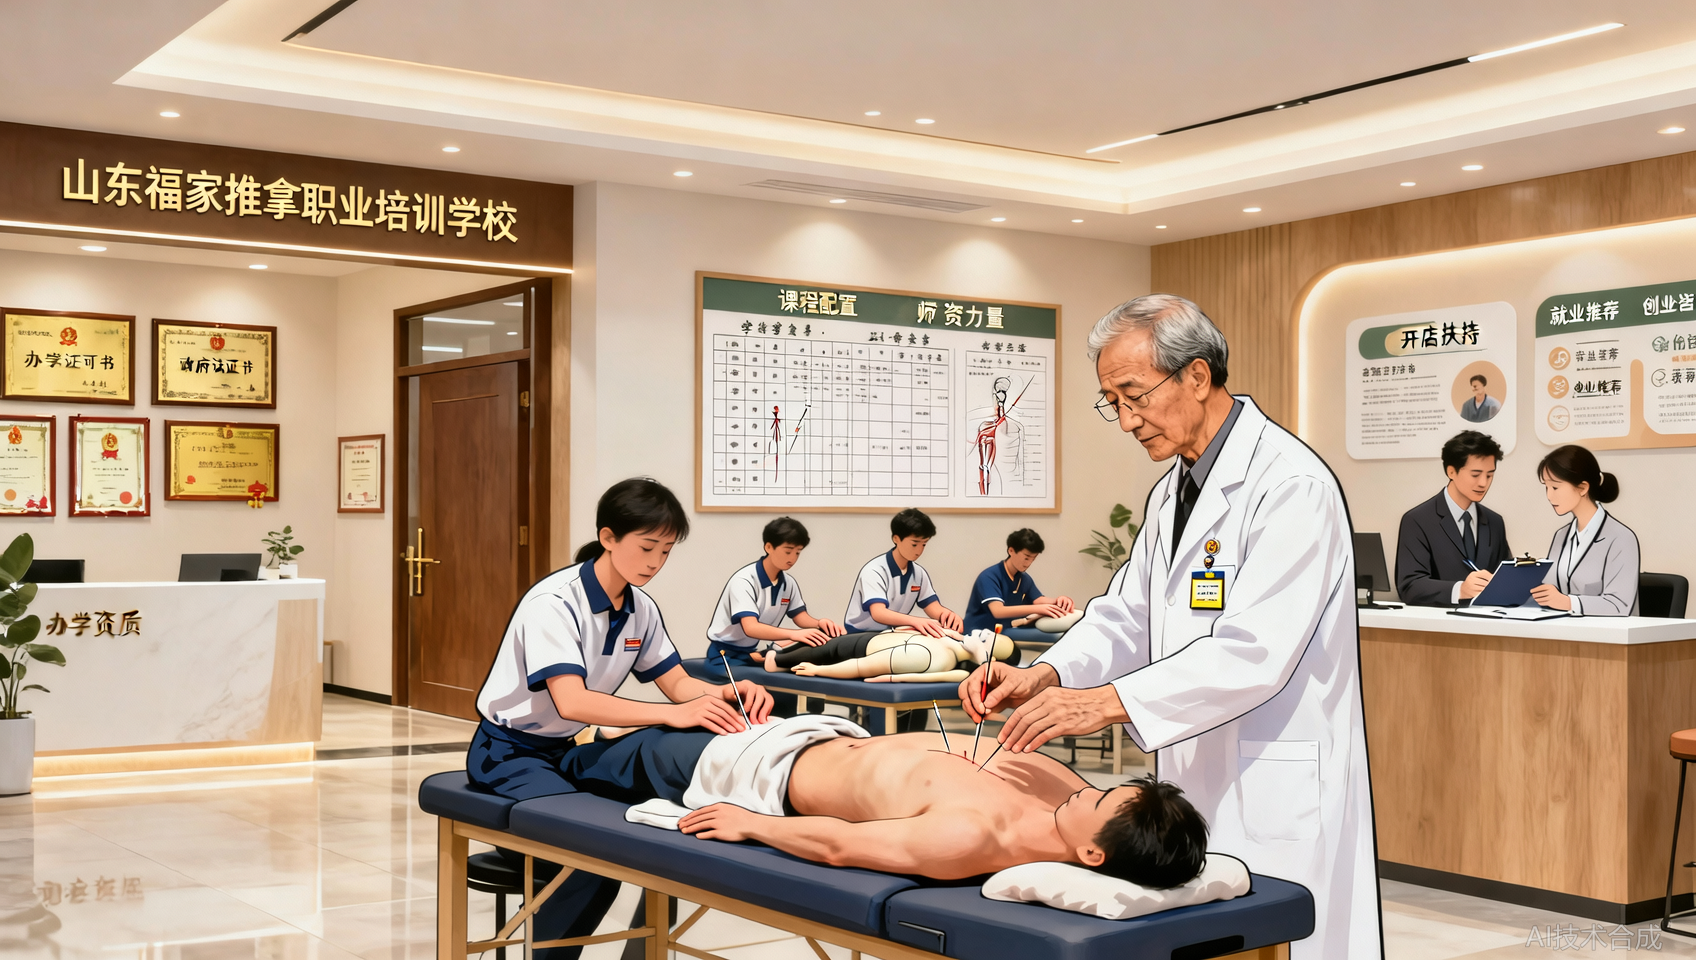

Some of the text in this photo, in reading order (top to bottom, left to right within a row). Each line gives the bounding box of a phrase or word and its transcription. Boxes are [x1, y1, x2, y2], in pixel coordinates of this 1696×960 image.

[62, 158, 519, 243] 山东福家推拿职业培训学校
[778, 289, 858, 317] 课程配置
[1549, 300, 1620, 326] 就业推荐
[1401, 320, 1479, 349] 开店扶持
[46, 609, 142, 637] 办学资质
